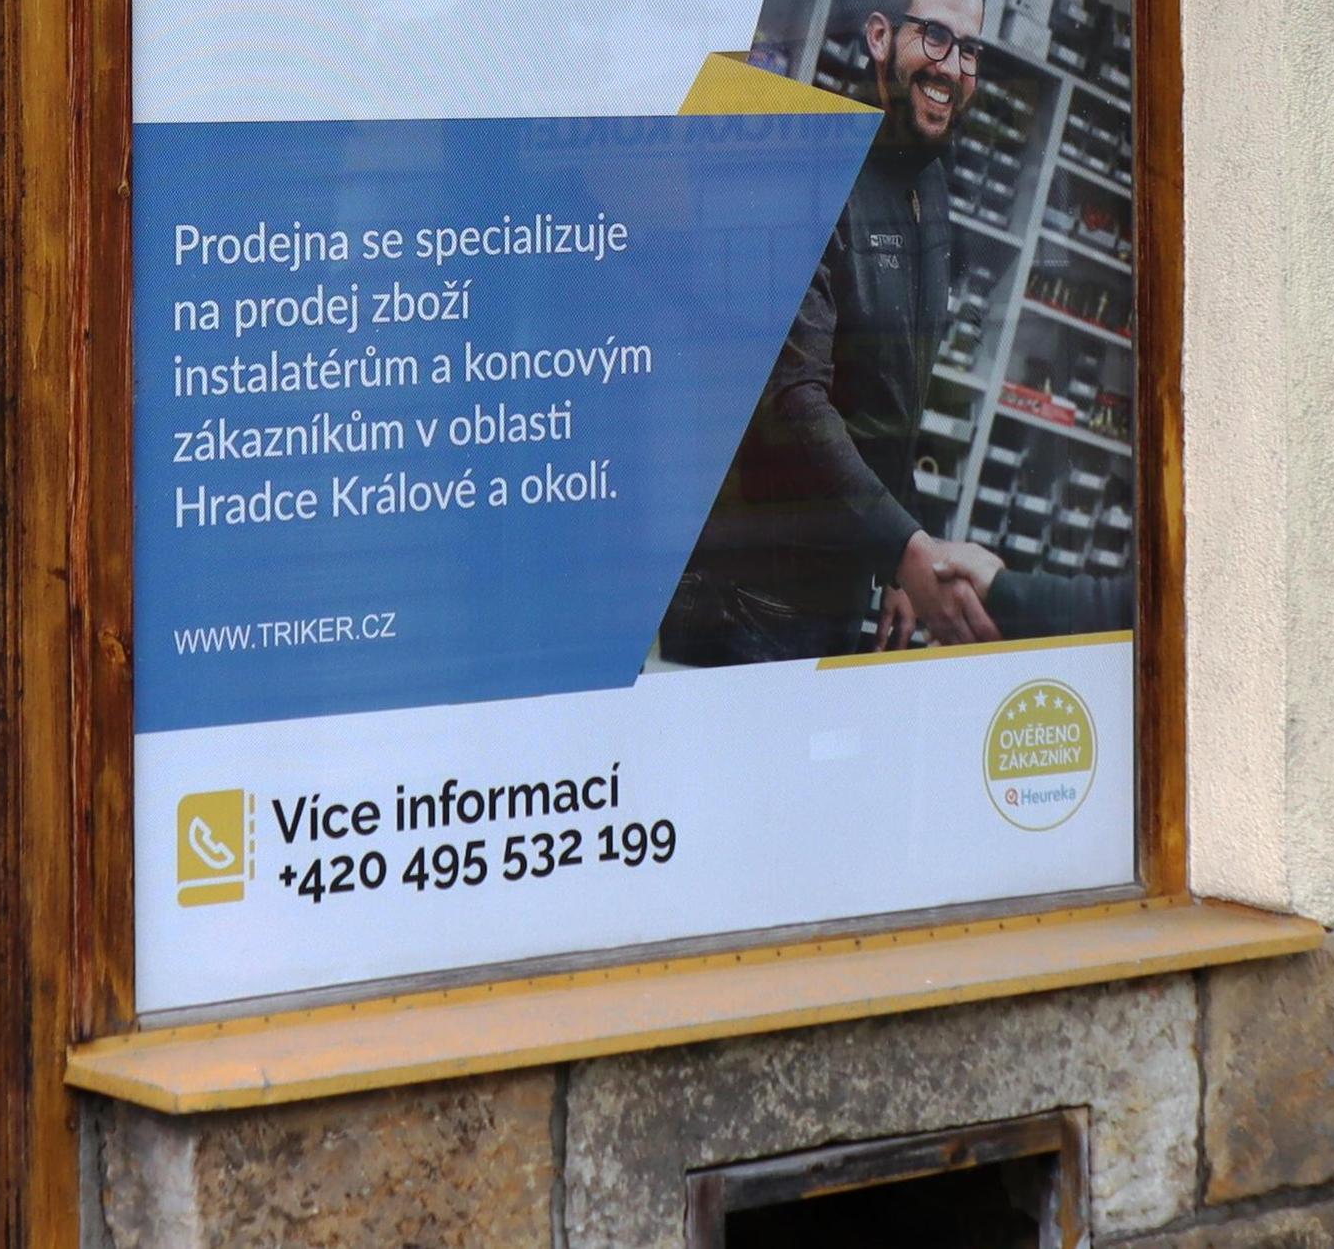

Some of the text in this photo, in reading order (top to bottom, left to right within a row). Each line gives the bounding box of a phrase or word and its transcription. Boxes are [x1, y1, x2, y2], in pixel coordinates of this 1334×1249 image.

[176, 213, 629, 272] Prodejna se specializuje
[175, 280, 472, 337] na prodej zboží
[175, 336, 652, 397] instalatérům a koncovým
[175, 400, 572, 462] zákazníkům v oblasti
[176, 460, 618, 528] Hradce Králové a okolí.
[175, 613, 396, 654] WWW.TRIKER.CZ
[999, 723, 1081, 749] OVĚŘENO
[999, 744, 1081, 771] ZÁKAZNÍKY
[273, 762, 621, 845] Více informací
[1021, 784, 1076, 805] Heureka
[279, 819, 677, 904] +420 495 532 199
